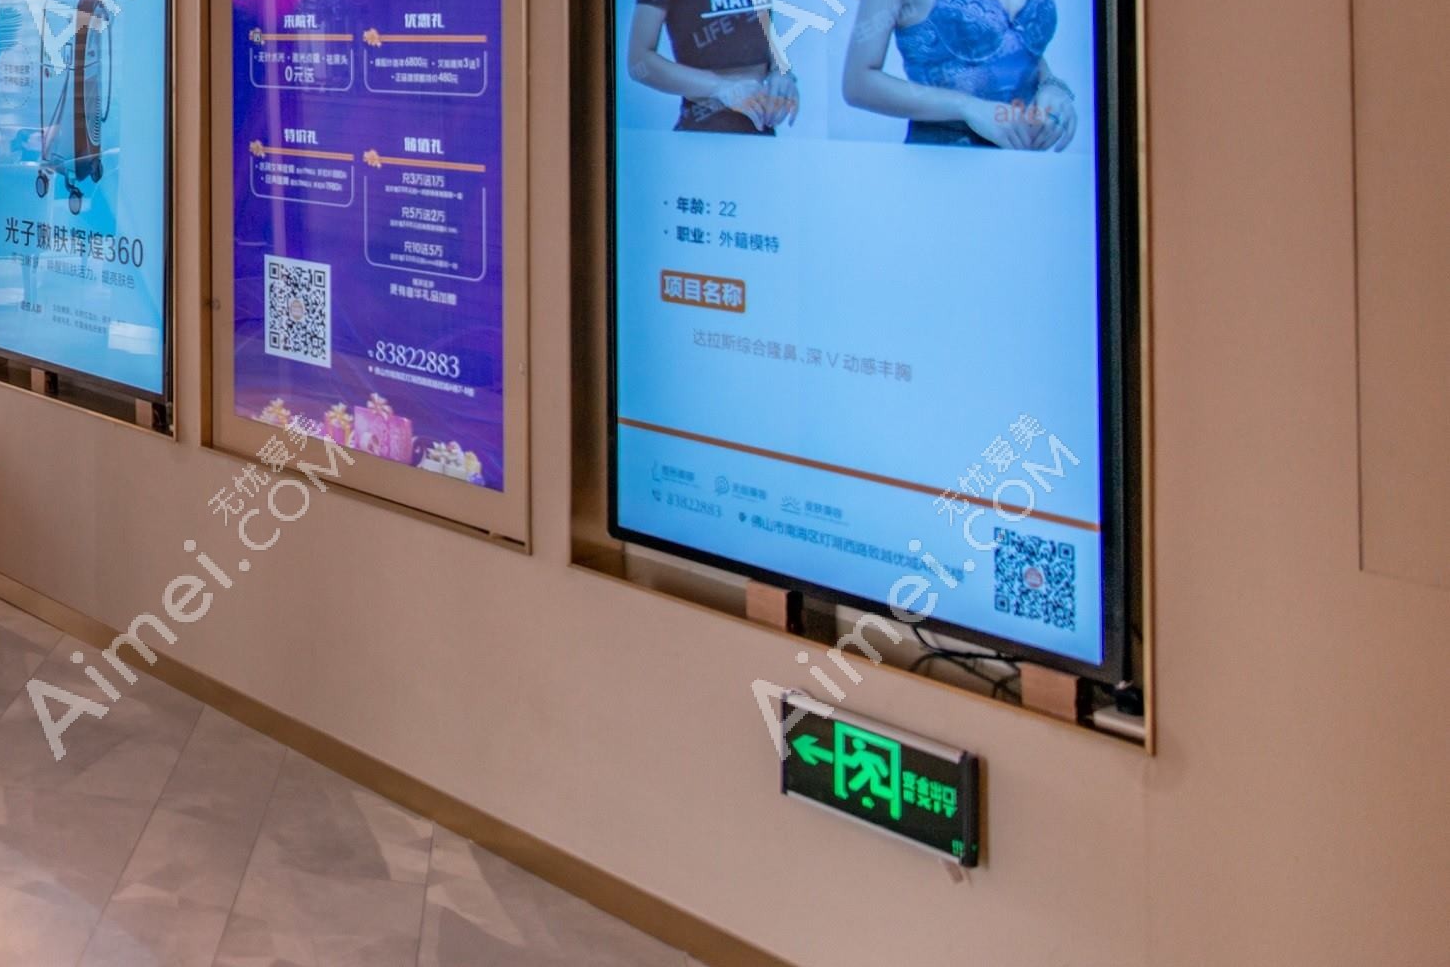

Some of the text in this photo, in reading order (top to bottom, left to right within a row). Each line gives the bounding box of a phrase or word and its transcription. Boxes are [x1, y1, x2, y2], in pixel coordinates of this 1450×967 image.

[662, 275, 744, 308] 项目名称
[375, 340, 461, 379] 83822883
